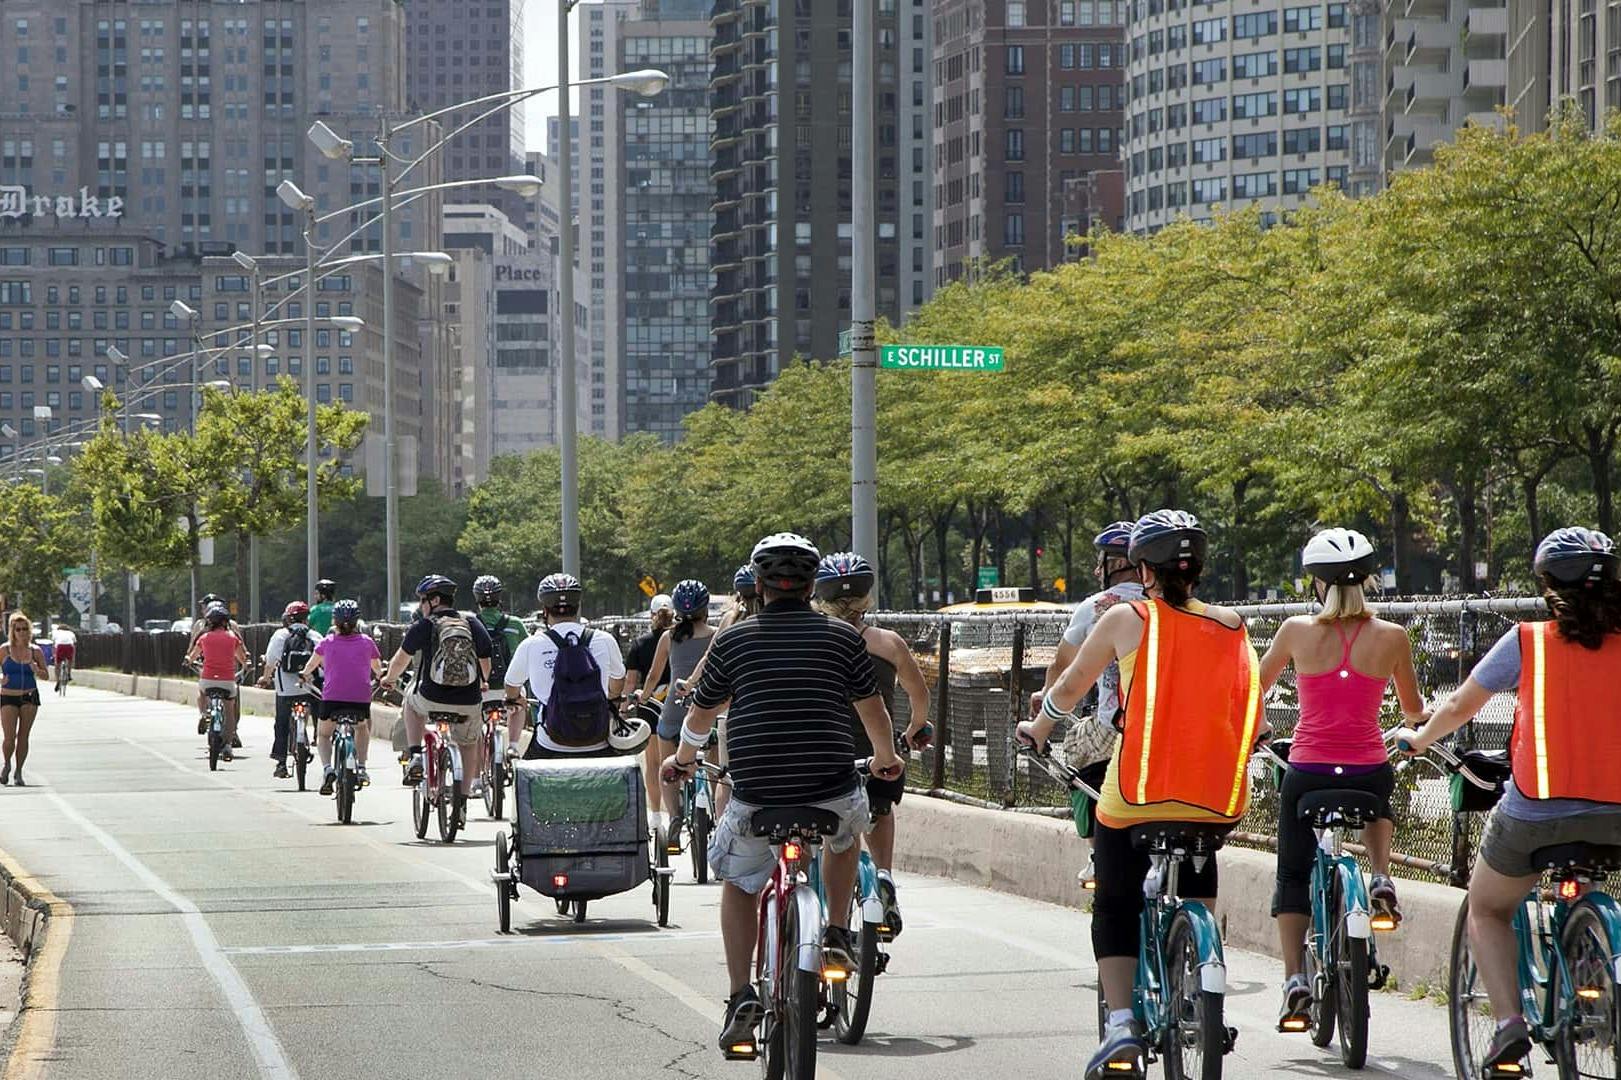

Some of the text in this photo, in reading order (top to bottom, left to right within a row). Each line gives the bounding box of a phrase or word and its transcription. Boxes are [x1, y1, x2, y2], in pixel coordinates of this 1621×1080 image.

[0, 184, 124, 218] Drake
[495, 264, 541, 281] Place
[887, 348, 1000, 368] E SCHILLER ST
[993, 590, 1016, 600] 4556
